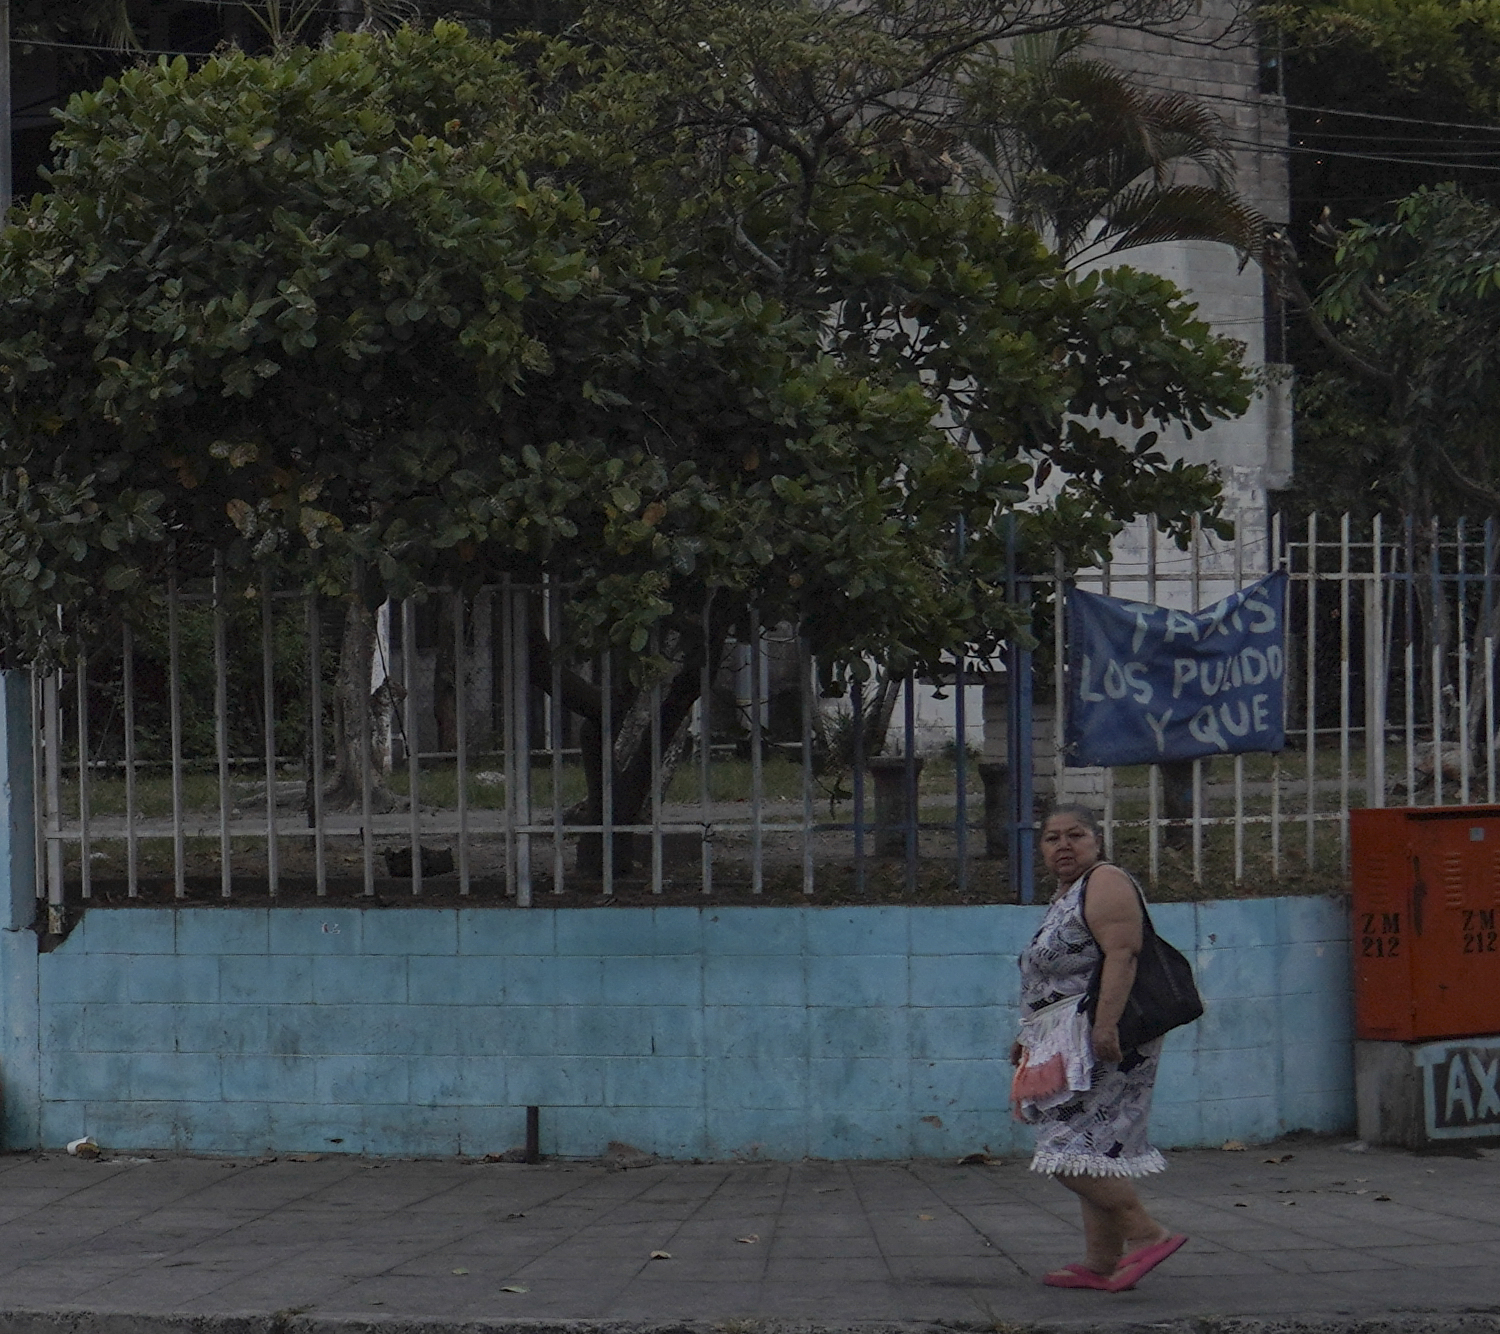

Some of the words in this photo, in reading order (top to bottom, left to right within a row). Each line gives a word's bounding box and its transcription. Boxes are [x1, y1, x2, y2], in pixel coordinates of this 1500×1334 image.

[1120, 586, 1276, 654] TAXIS
[1079, 654, 1154, 705] LOS
[1145, 708, 1173, 752] Y
[1188, 693, 1269, 752] QUE
[1361, 937, 1400, 958] 212
[1463, 931, 1498, 954] 212
